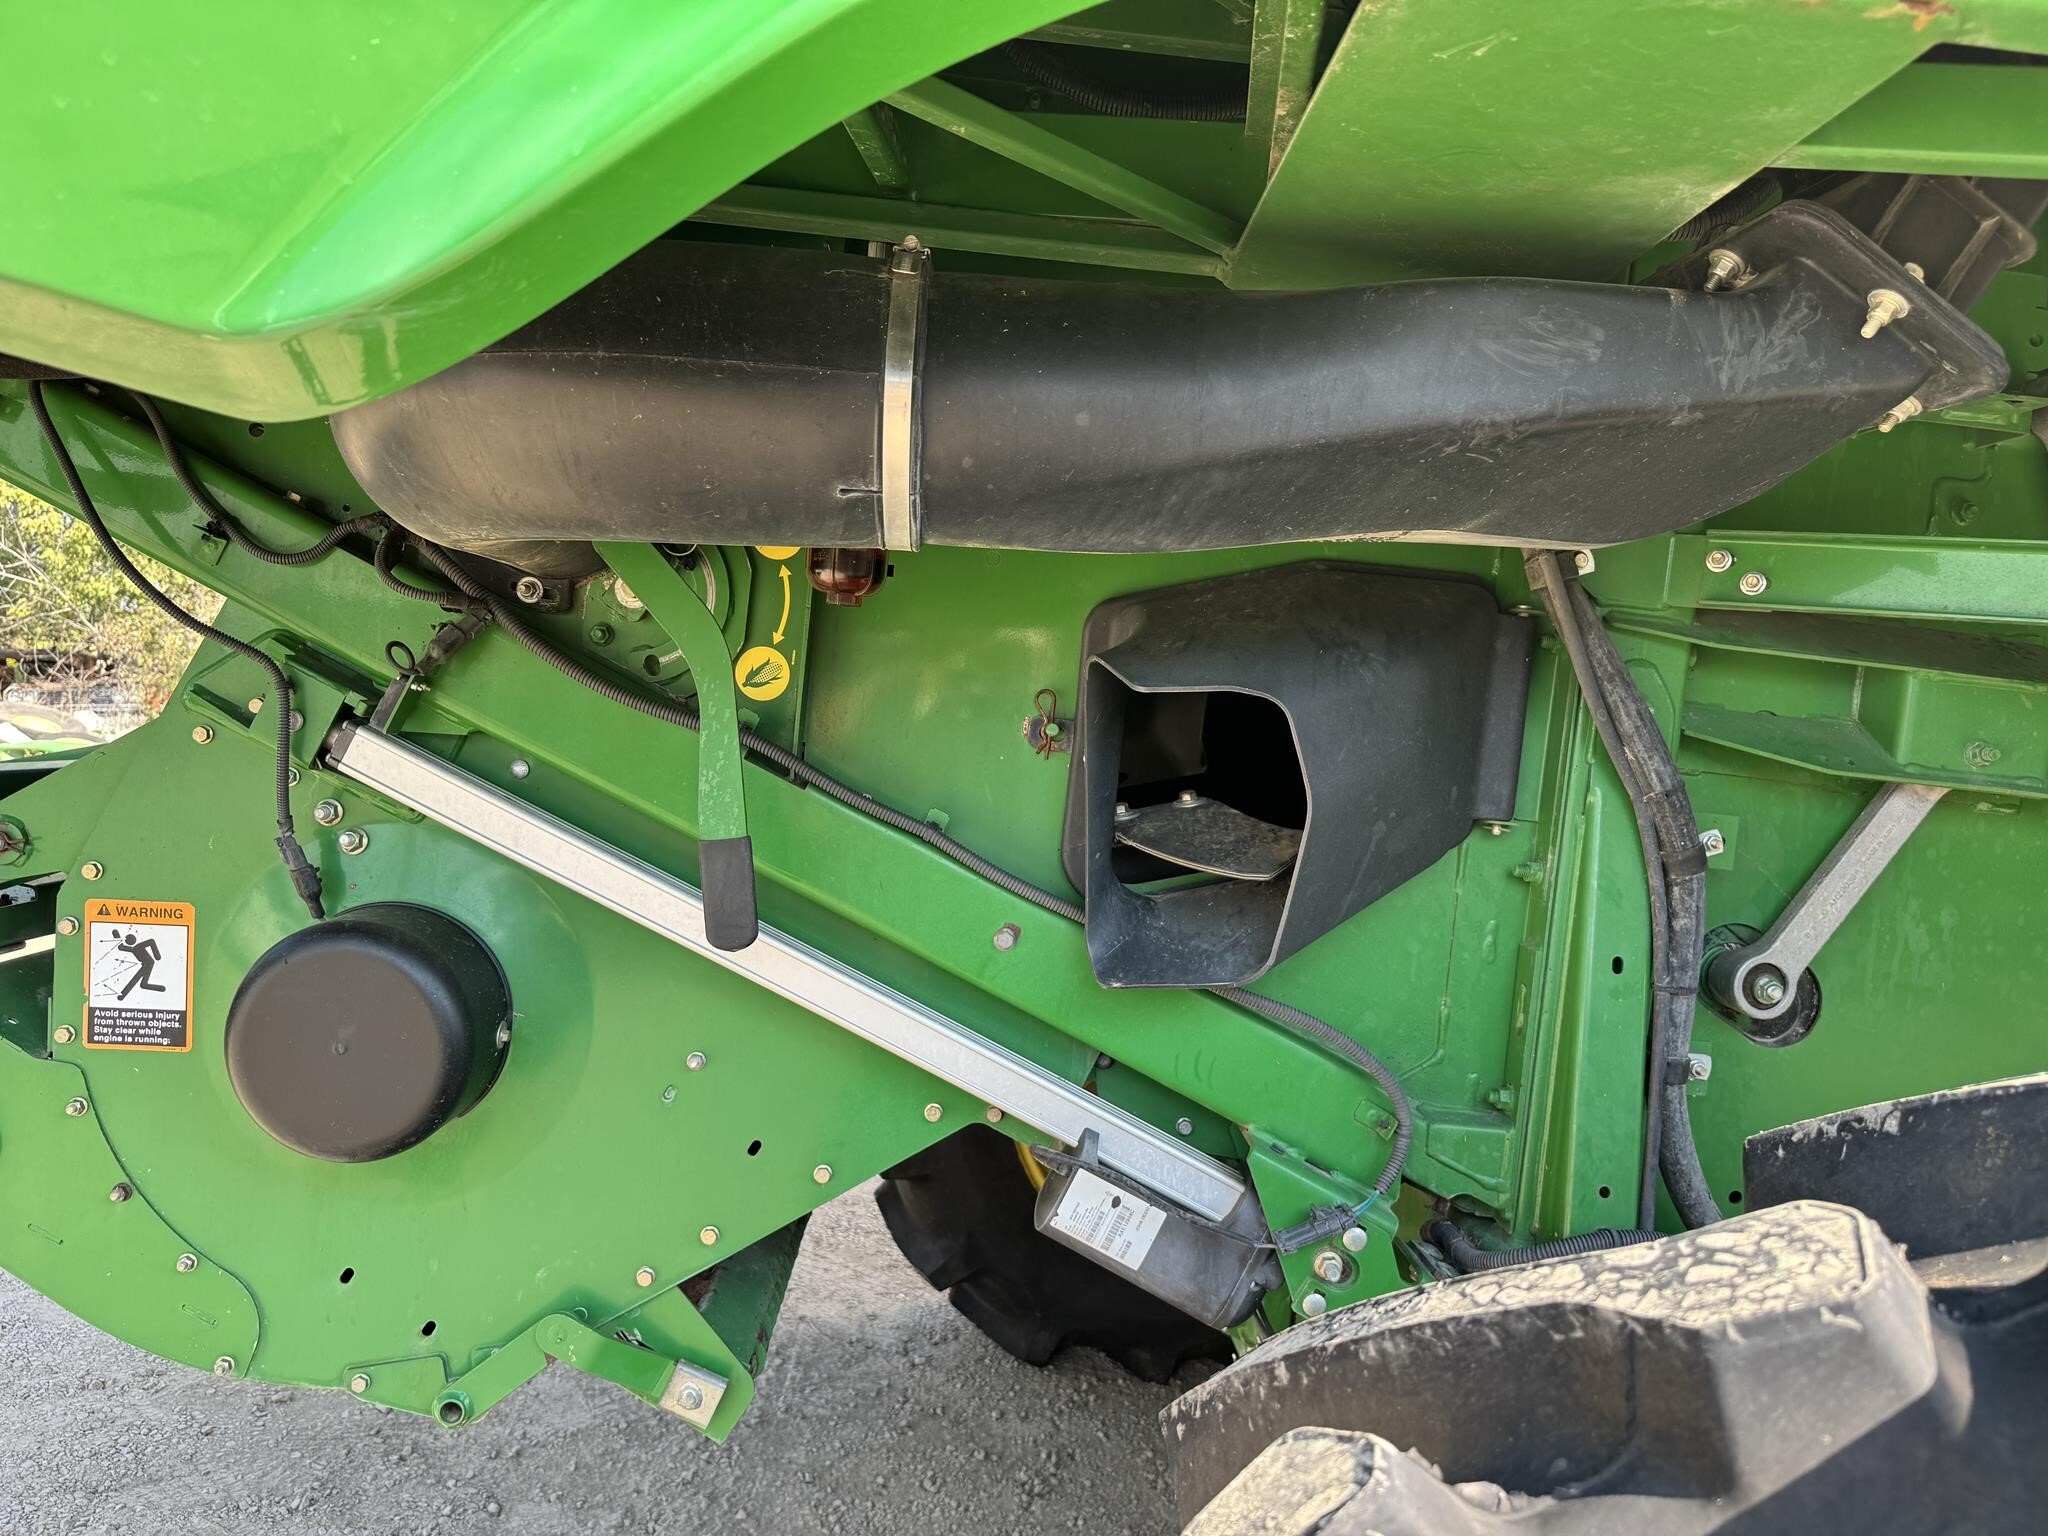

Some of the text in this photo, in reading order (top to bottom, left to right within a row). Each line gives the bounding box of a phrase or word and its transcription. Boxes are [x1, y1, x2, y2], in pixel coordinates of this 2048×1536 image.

[116, 906, 183, 919] WARNING
[94, 1009, 180, 1021] Avoid serious injury
[116, 1019, 146, 1027] thrown
[148, 1019, 182, 1029] objects.
[94, 1026, 112, 1035] Stay
[138, 1027, 161, 1035] while
[93, 1035, 122, 1043] engine
